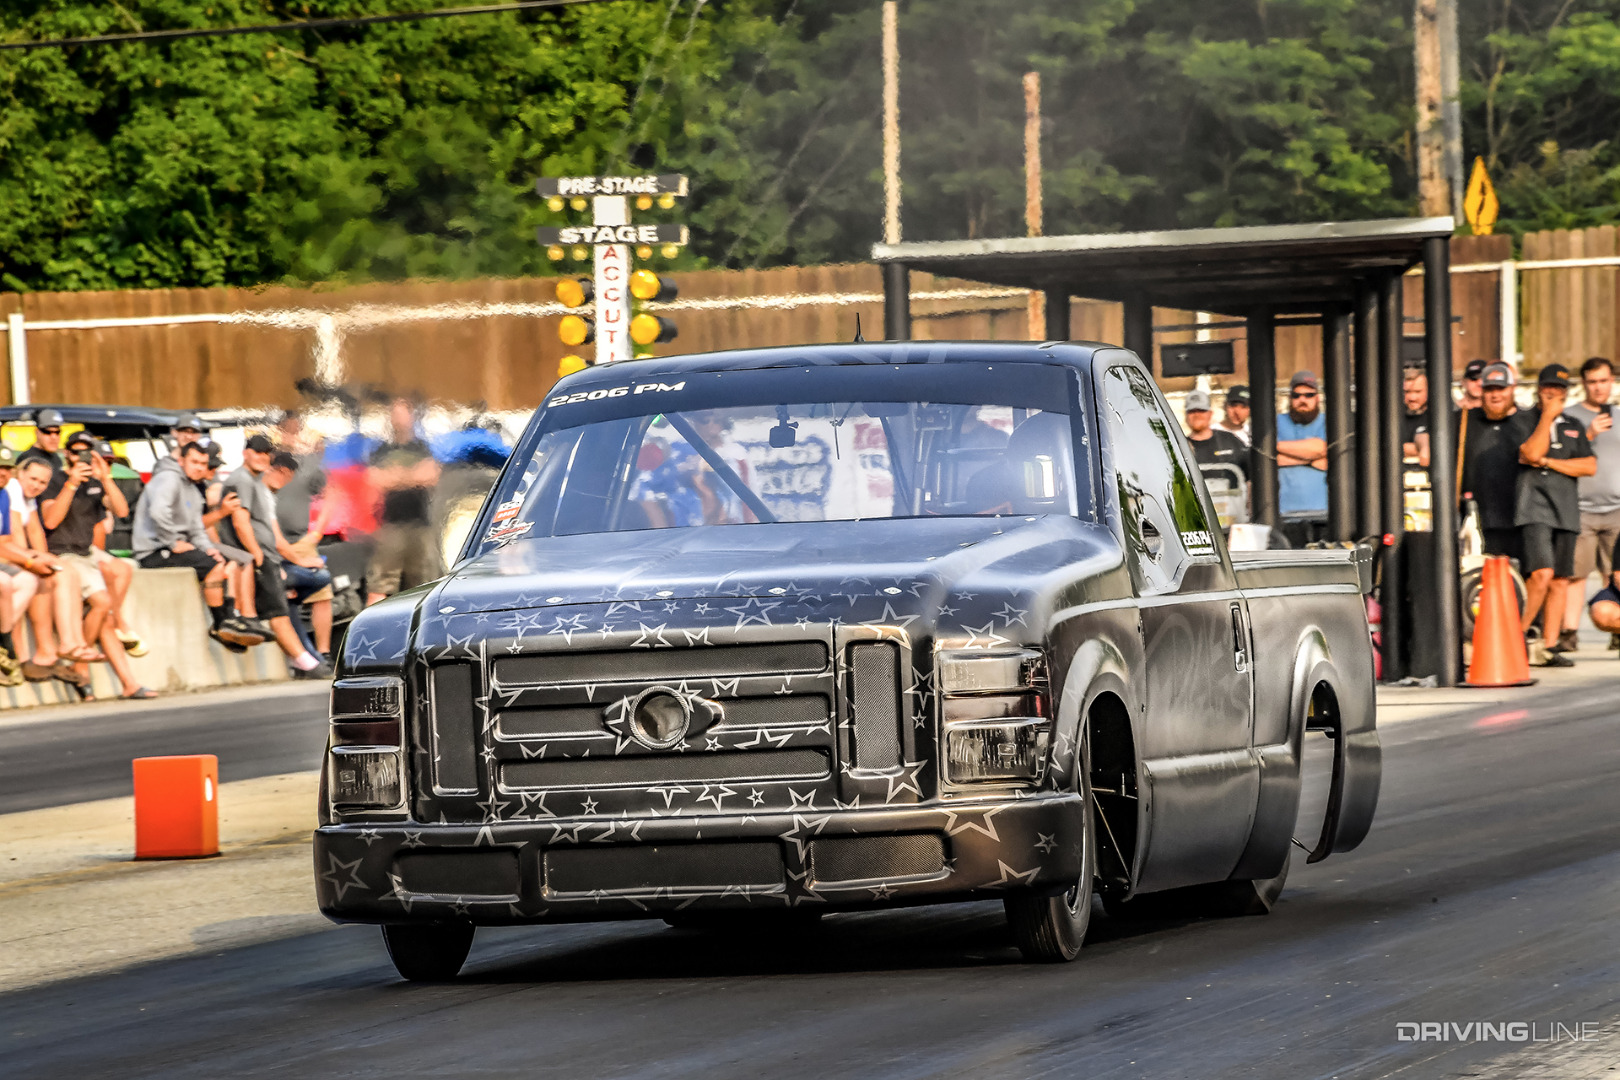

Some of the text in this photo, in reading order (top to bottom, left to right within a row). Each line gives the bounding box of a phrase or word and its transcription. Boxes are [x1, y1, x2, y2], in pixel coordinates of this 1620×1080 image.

[559, 225, 658, 243] STAGE
[547, 381, 686, 408] 2206 PM
